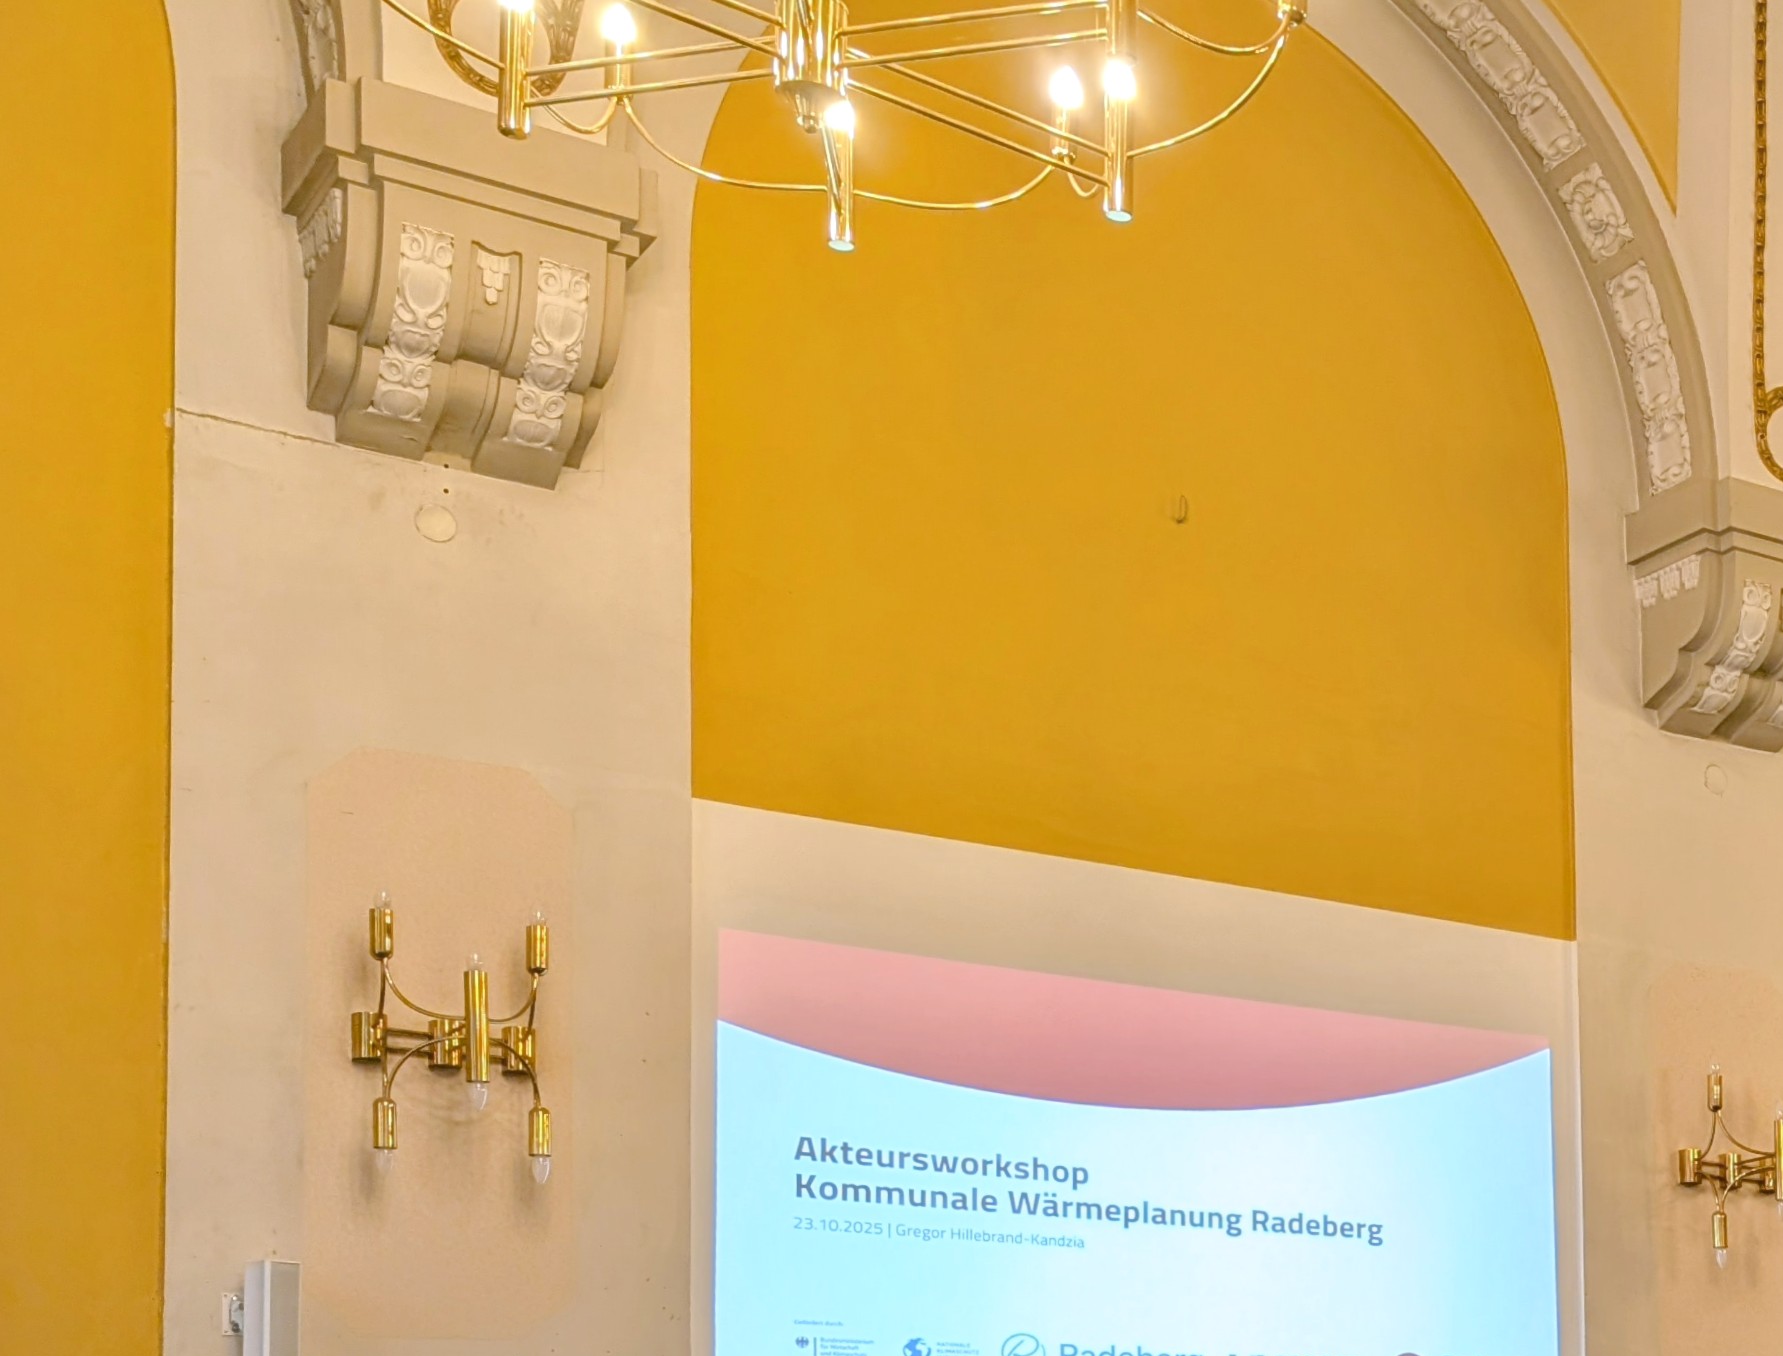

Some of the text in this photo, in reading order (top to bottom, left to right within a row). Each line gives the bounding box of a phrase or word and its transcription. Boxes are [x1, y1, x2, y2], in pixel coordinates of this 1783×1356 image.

[794, 1136, 1090, 1190] Akteursworkshop
[793, 1216, 884, 1236] 23.10.2025
[895, 1224, 947, 1242] Gregor
[950, 1228, 1086, 1249] Hillebrand-Kandzia
[795, 1172, 1384, 1247] Kommunale Wärmeplanung Radeberg
